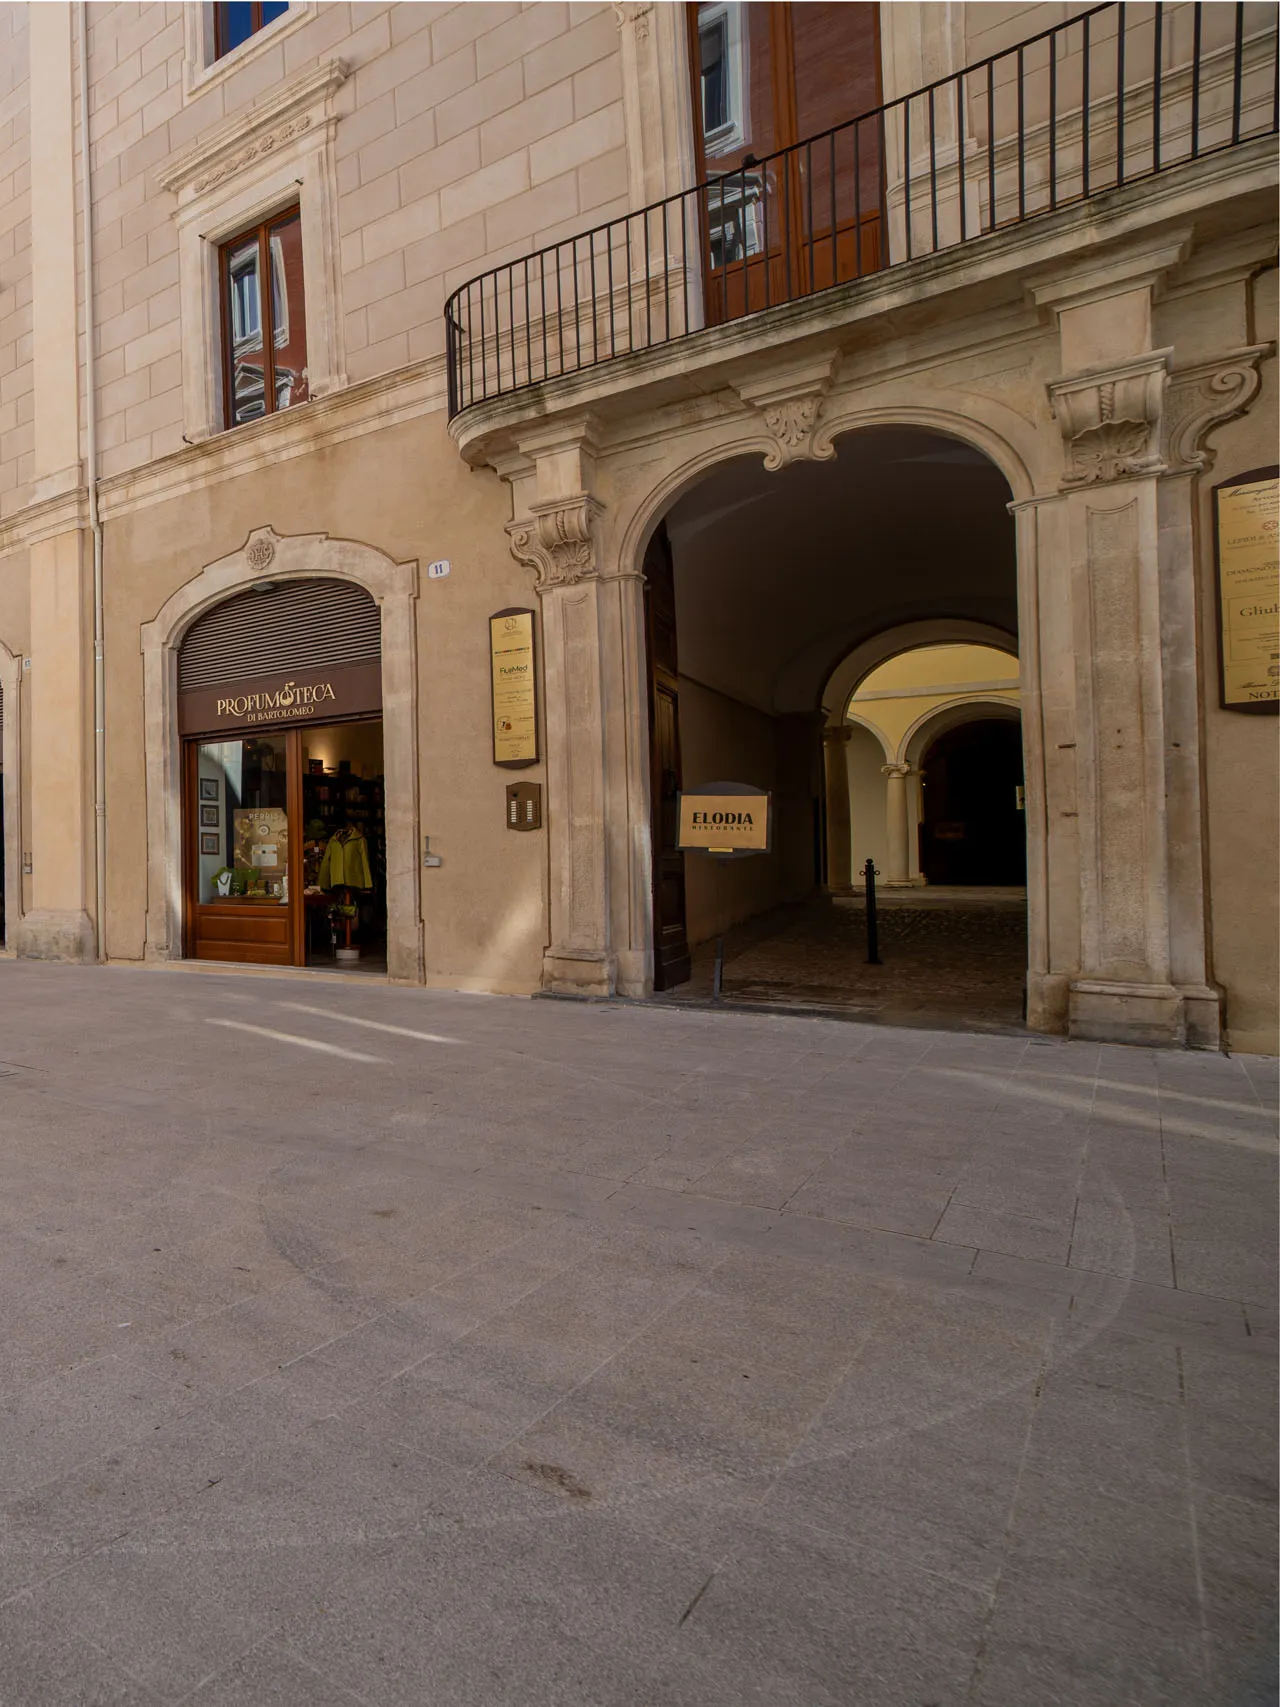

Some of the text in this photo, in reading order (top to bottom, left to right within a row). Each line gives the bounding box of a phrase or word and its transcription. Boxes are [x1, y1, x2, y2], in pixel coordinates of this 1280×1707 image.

[216, 682, 336, 717] PROFUMOTECA
[247, 705, 315, 722] DI BARTOLOMEO
[692, 812, 753, 825] ELODIA
